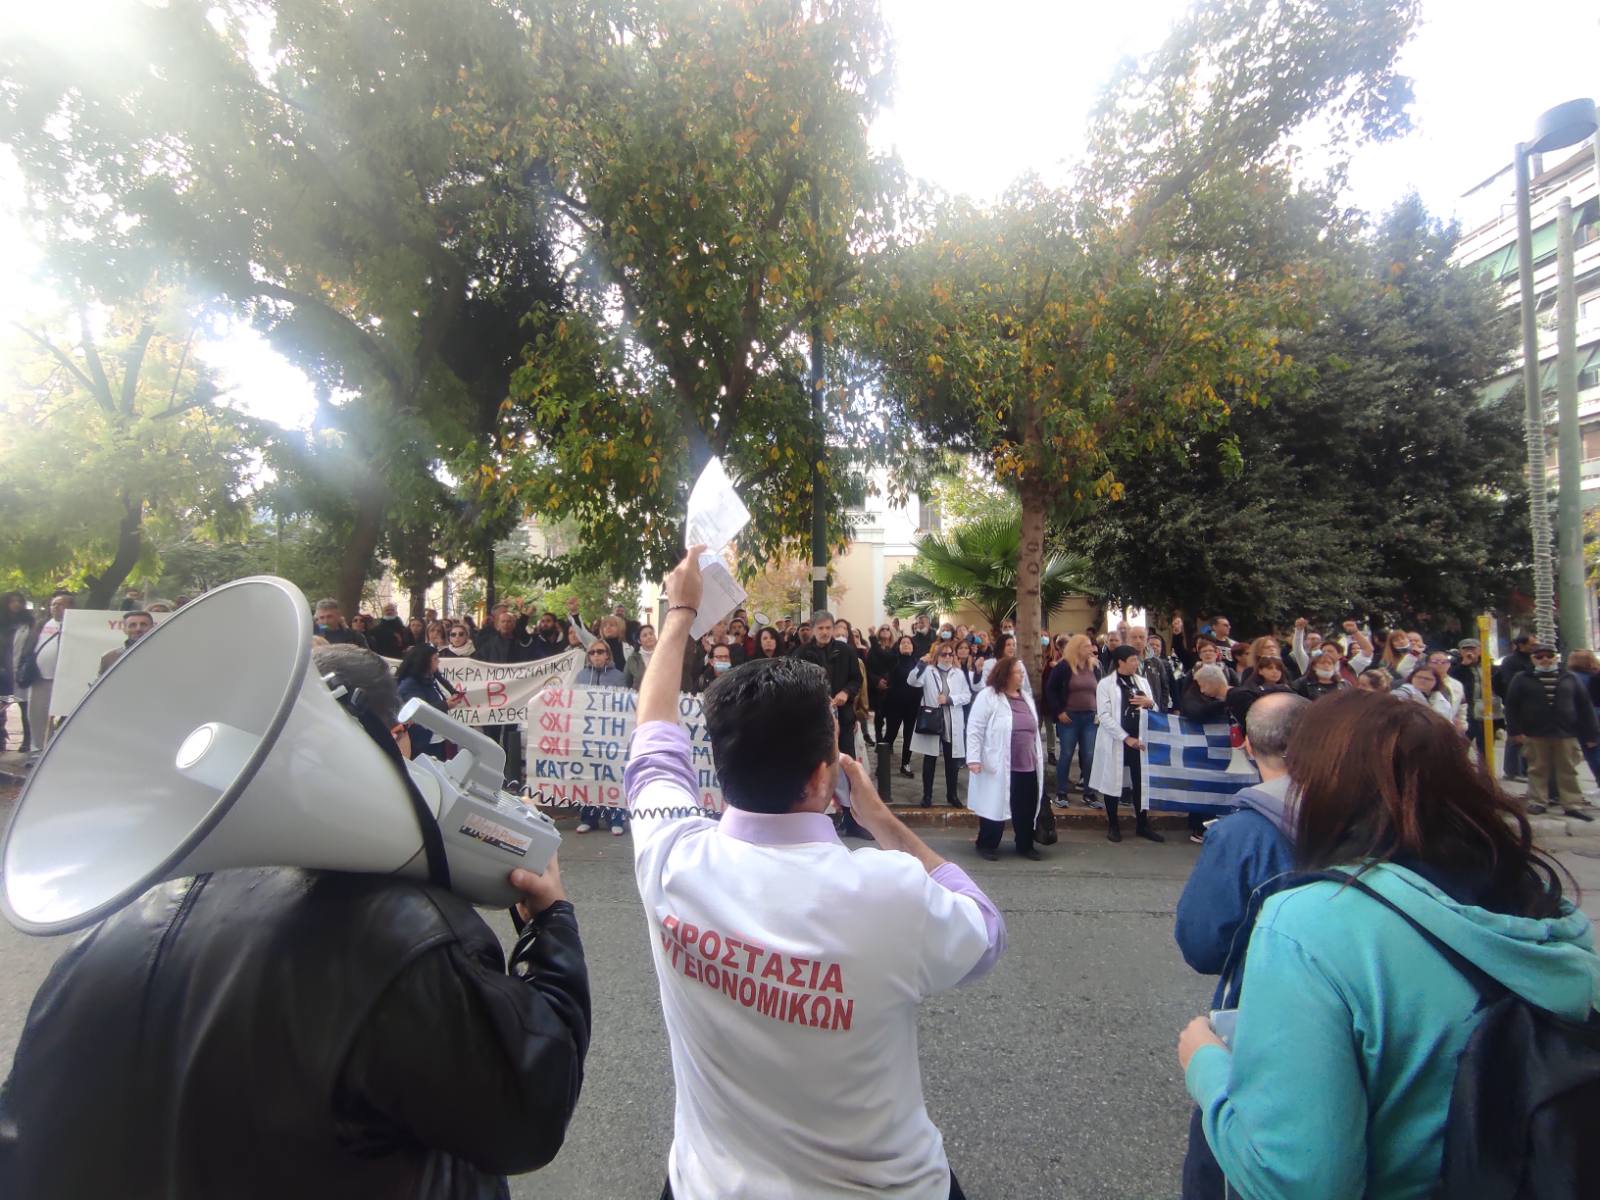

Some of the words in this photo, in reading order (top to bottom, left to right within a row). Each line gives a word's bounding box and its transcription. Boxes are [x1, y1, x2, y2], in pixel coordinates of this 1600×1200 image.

[539, 689, 574, 709] ΟΧΙ
[538, 711, 572, 733] ΟΧΙ
[582, 716, 626, 737] ΣΤΗ
[537, 735, 571, 757] ΟΧΙ
[581, 740, 620, 760] ΣΤΟ
[662, 914, 844, 994] ΠΡΟΣΤΑΣΙΑ
